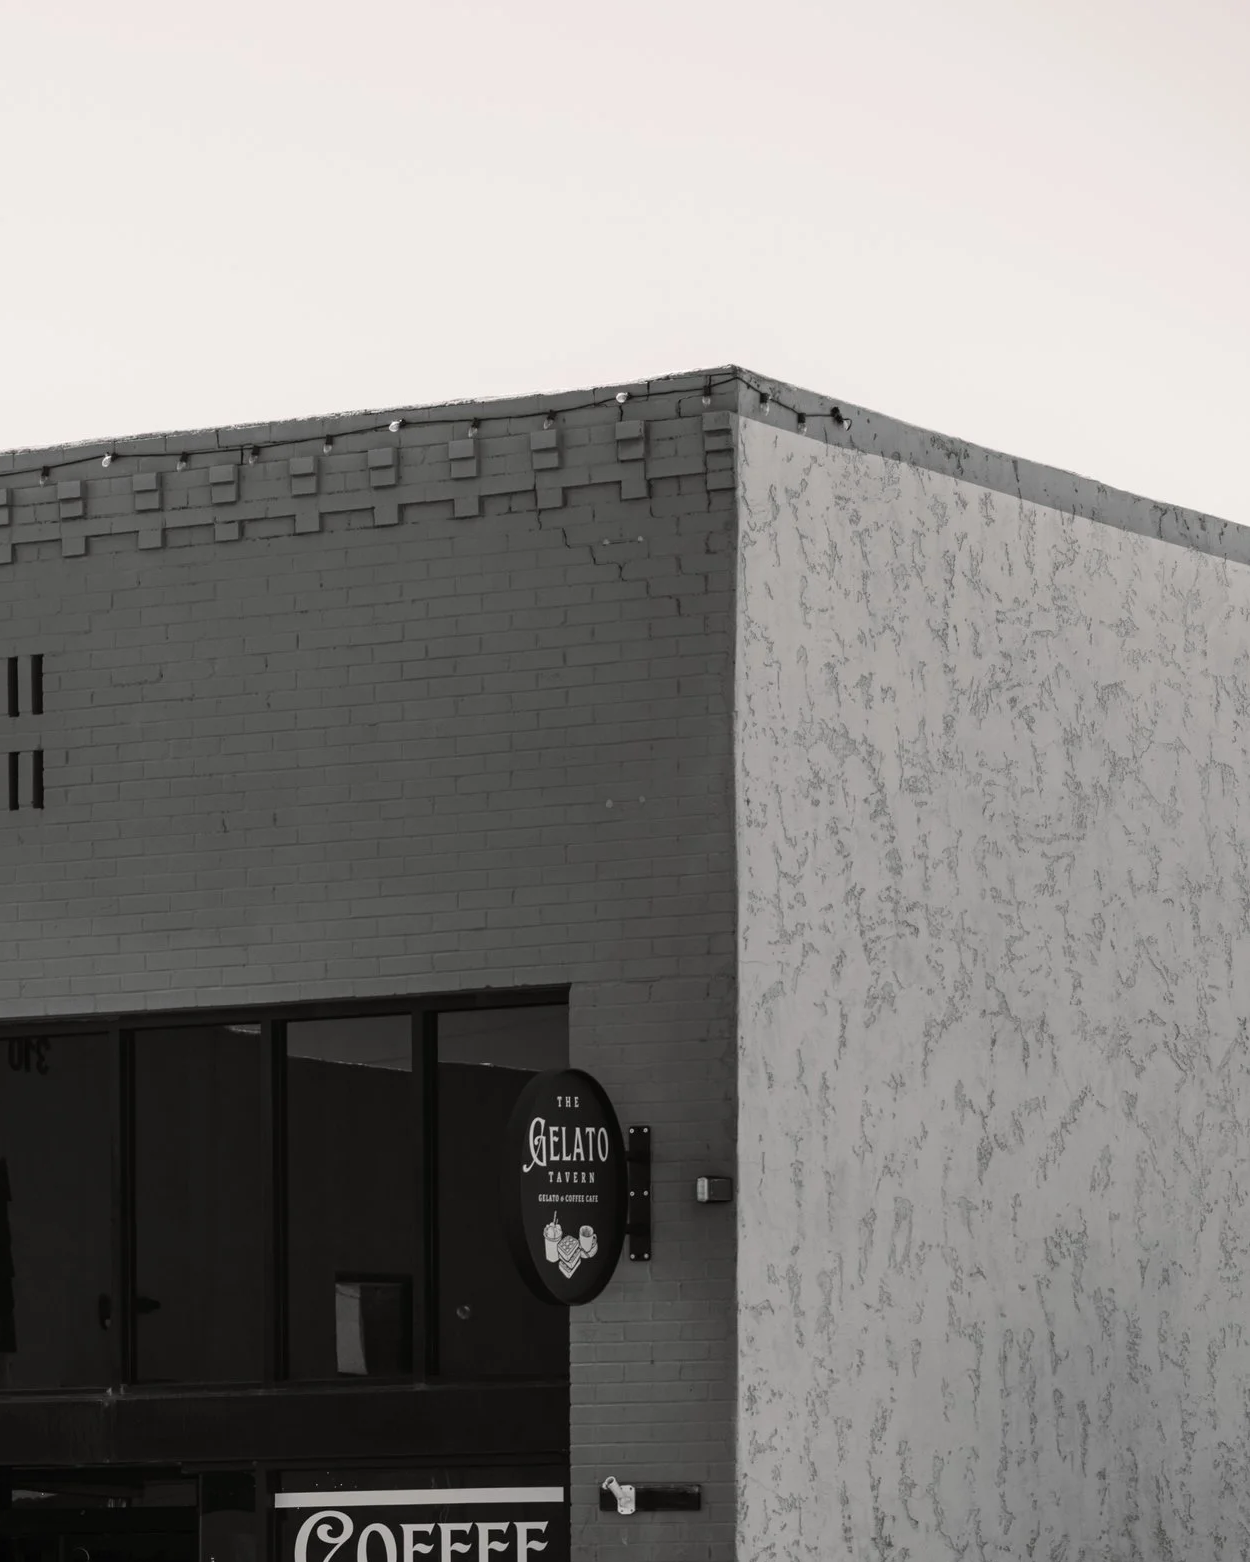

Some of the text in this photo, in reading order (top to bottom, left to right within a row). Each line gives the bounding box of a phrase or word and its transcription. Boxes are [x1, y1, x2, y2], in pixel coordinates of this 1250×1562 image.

[556, 1096, 580, 1108] THE
[522, 1117, 609, 1173] GELATO
[548, 1171, 595, 1184] TAVERN
[538, 1194, 559, 1203] GELATO
[565, 1194, 585, 1203] COFFEE
[585, 1194, 598, 1203] CAFE
